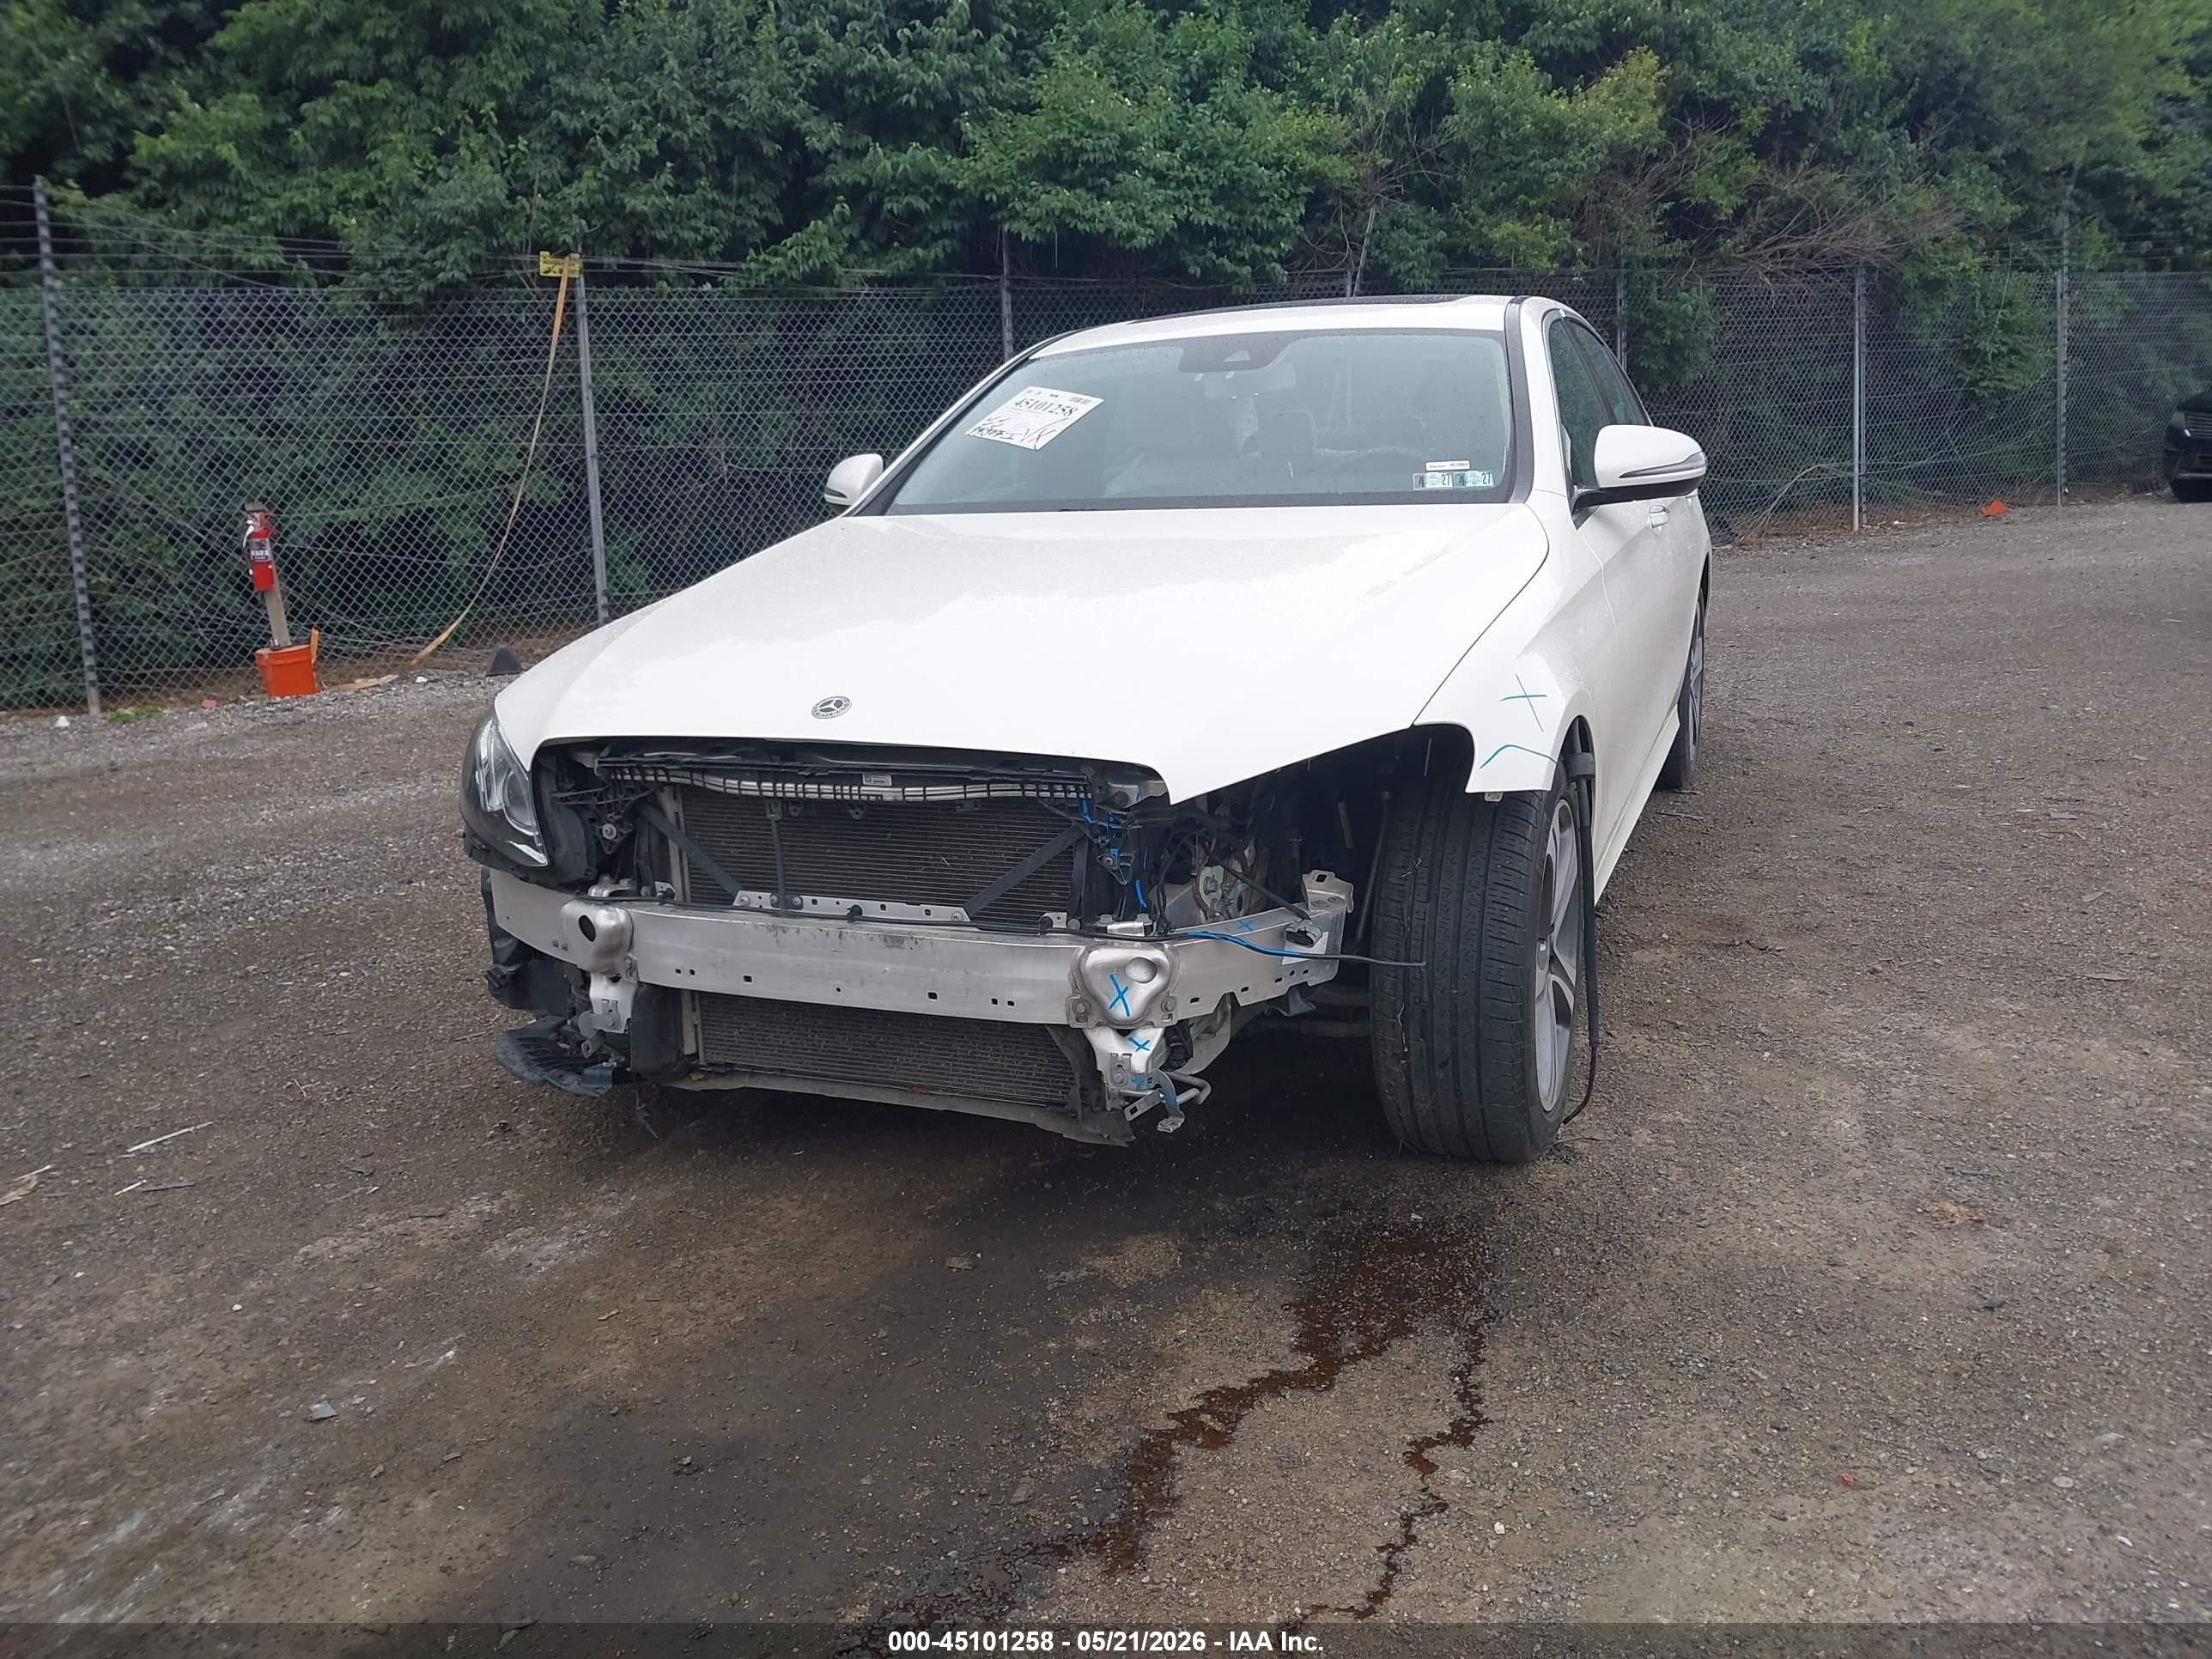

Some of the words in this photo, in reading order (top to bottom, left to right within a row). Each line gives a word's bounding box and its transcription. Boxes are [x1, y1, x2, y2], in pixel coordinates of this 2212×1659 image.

[1014, 398, 1079, 416] 45101258
[1441, 473, 1450, 486] 27
[1481, 472, 1491, 484] 27
